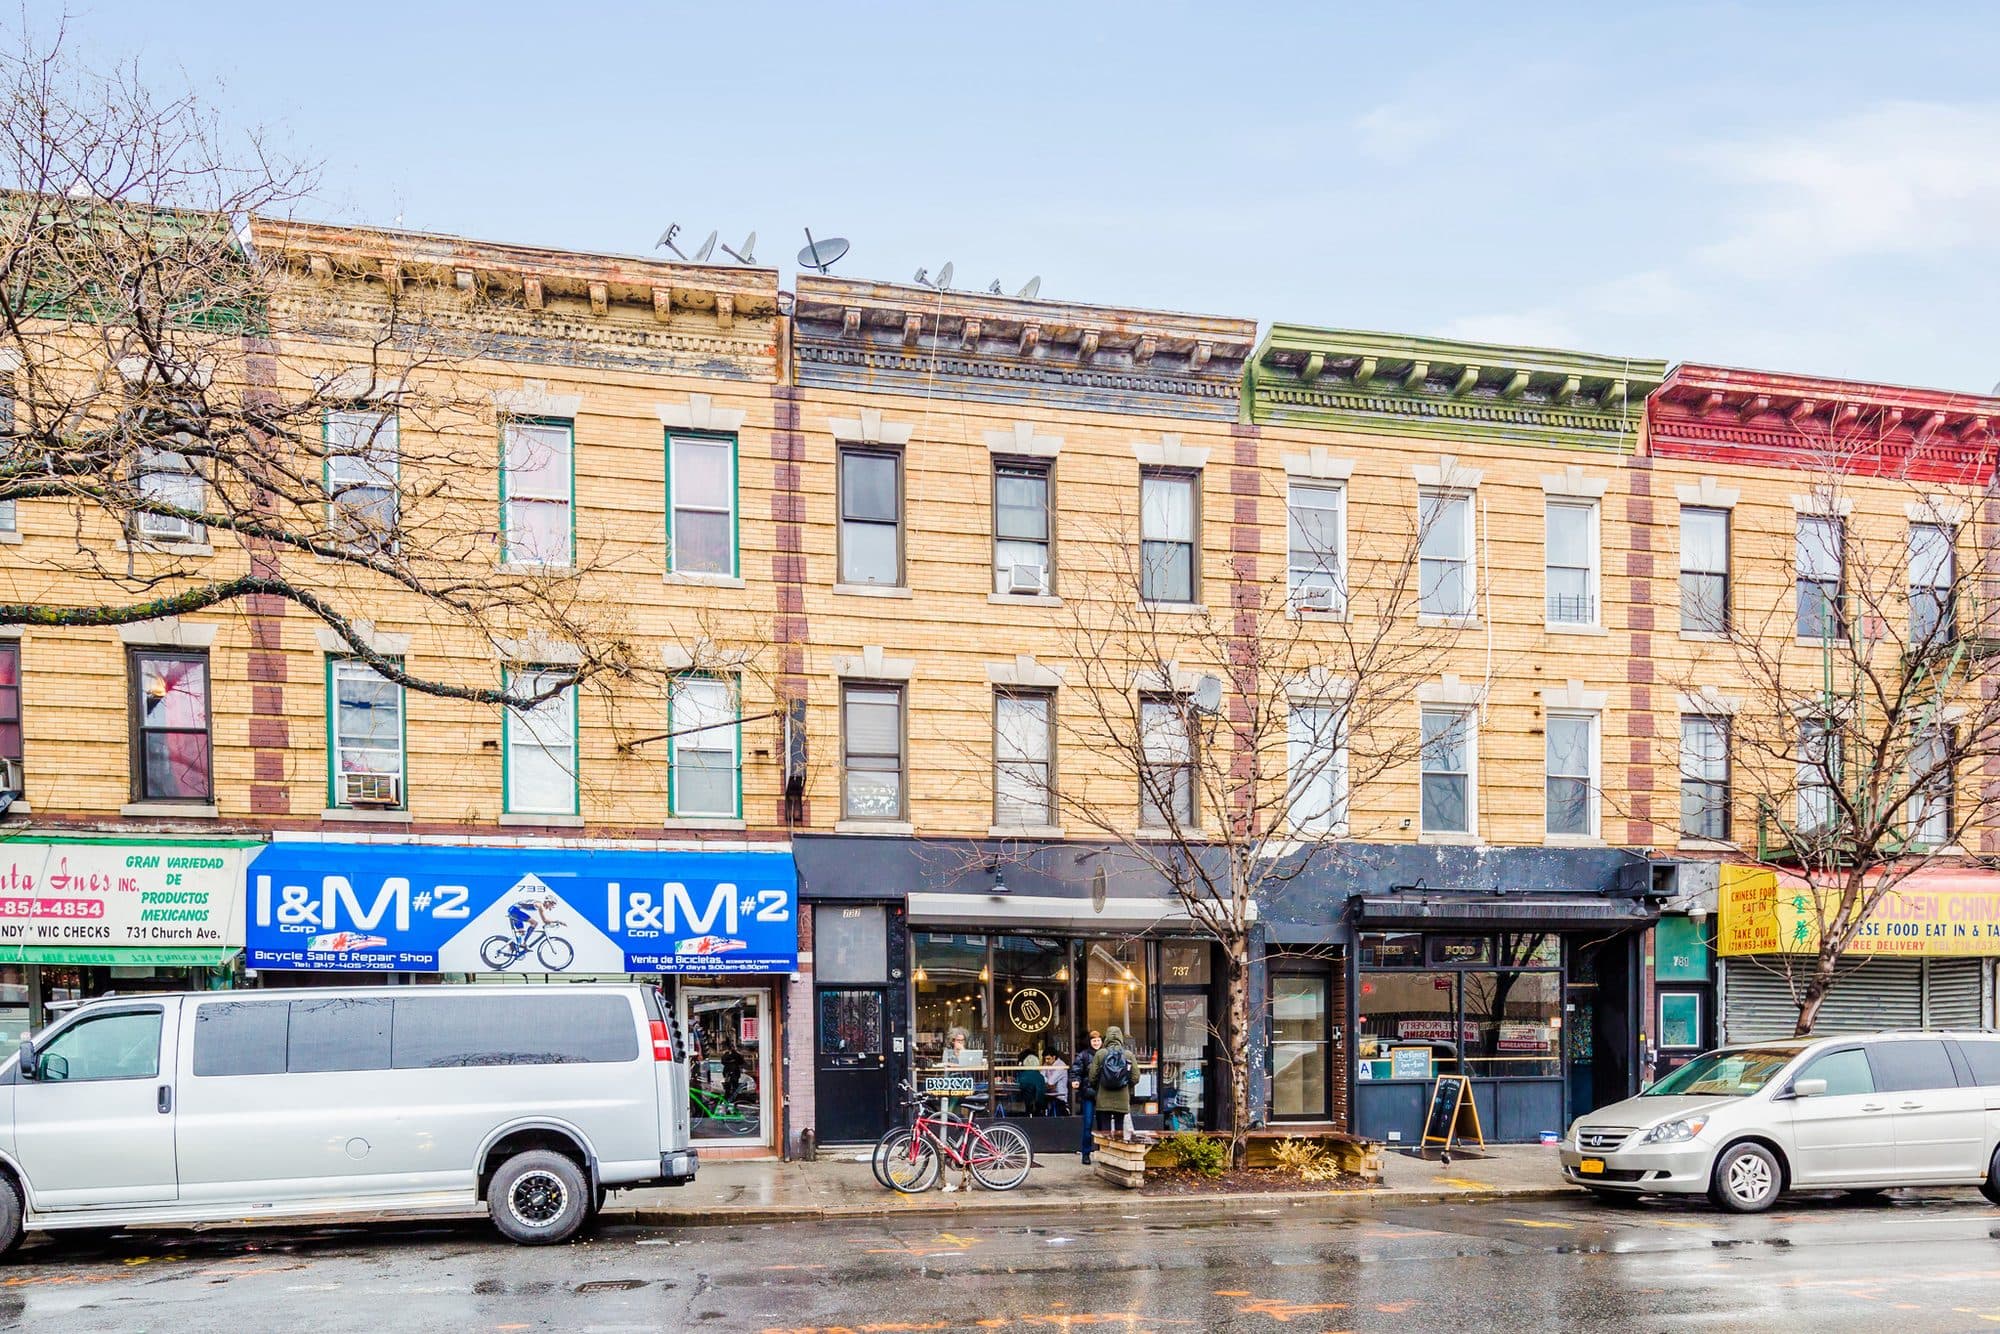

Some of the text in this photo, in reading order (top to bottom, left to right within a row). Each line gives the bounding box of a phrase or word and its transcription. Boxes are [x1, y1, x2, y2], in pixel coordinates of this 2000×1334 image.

[126, 856, 224, 869] GRAN VARIEDAD
[118, 878, 140, 892] INC.
[166, 874, 182, 885] DE
[141, 892, 209, 904] PRODUCTOS
[1731, 886, 1776, 902] CHINESE FOOD
[1743, 902, 1767, 913] EAT IN
[1864, 895, 1939, 920] OLDEN
[141, 910, 209, 921] MEXICANOS
[37, 926, 60, 938] WIC
[64, 926, 110, 938] CHECKS
[127, 927, 221, 939] 731 Church Ave.
[280, 924, 317, 934] Corp
[628, 929, 659, 940] Corp
[1734, 927, 1769, 939] TAKE OUT
[1887, 923, 1919, 936] FOOD
[1926, 924, 1947, 936] EAT
[1954, 924, 1965, 936] IN
[1972, 925, 1979, 936] &
[1877, 941, 1925, 950] DELIVERY
[255, 951, 433, 964] Bicycle Sale & Repair Shop
[631, 955, 658, 964] Venta
[660, 955, 672, 964] de
[1172, 966, 1189, 976] 737
[1014, 1016, 1048, 1030] PIONEER
[1360, 1063, 1370, 1074] A
